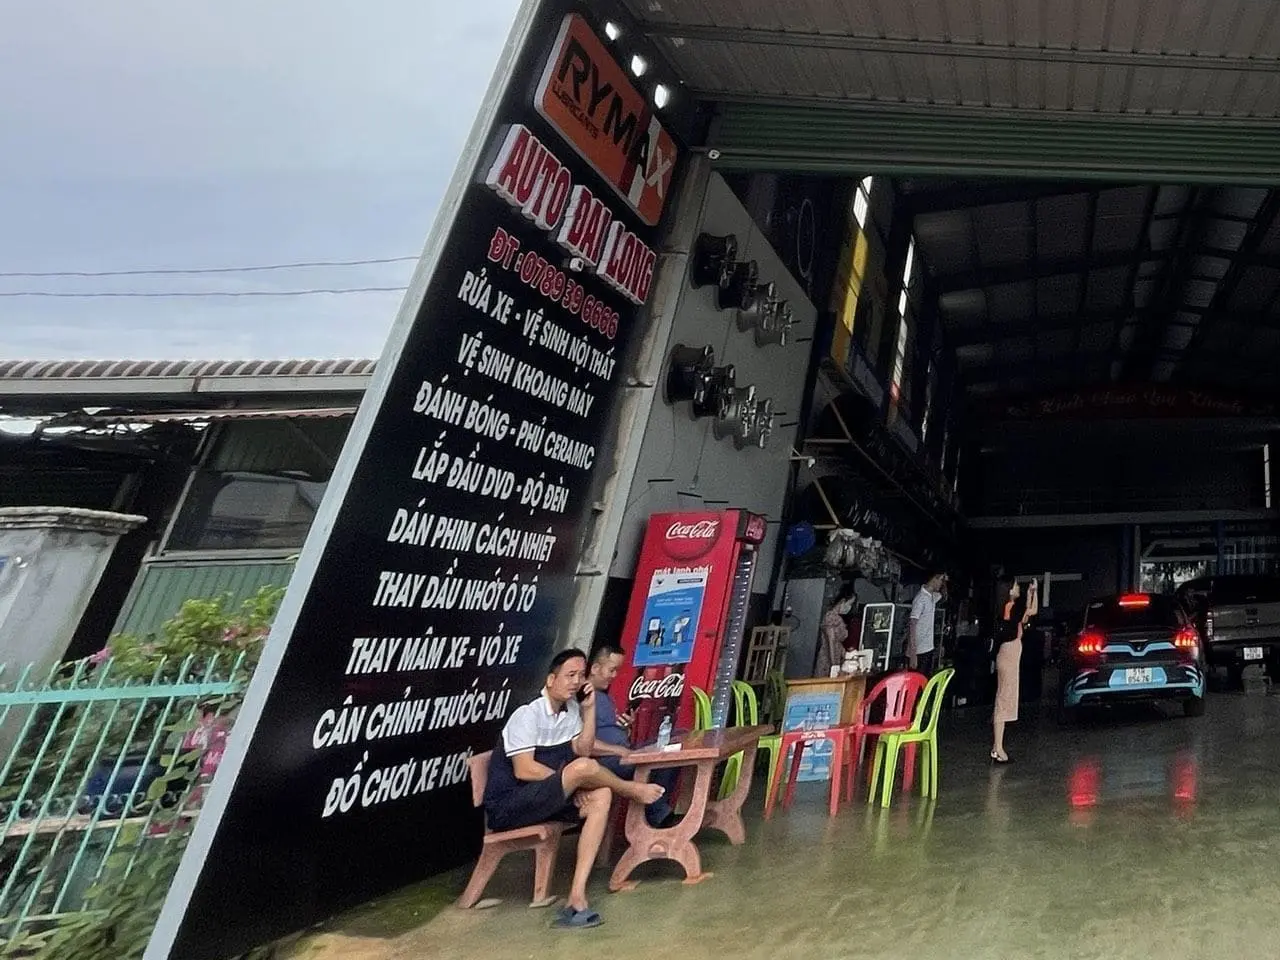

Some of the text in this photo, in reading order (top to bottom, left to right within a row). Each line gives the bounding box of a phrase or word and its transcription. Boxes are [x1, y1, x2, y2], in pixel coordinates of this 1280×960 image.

[559, 37, 673, 198] RYMAX
[488, 124, 572, 230] AUTO
[602, 221, 656, 305] LONG
[458, 267, 492, 314] RỬA
[490, 291, 515, 325] XE
[523, 308, 544, 346] VỆ
[540, 320, 571, 356] SINH
[567, 335, 591, 373] NỘI
[588, 346, 616, 381] THẤT
[562, 279, 584, 314] 39
[581, 295, 620, 339] 6666
[457, 331, 595, 418] VỆ SINH KHOANG MÁY
[412, 374, 468, 426] ĐÁNH
[463, 394, 510, 441] BÓNG
[514, 416, 548, 453] PHỦ
[544, 431, 596, 470] CERAMIC
[411, 430, 449, 483] LẮP
[446, 442, 485, 493] ĐẦU
[481, 468, 515, 500] DVD
[520, 471, 546, 516] ĐỘ
[542, 476, 570, 513] ĐÈN
[387, 497, 557, 570] DÁN PHIM CÁCH NHIỆT
[373, 557, 538, 613] THAY DẦU NHỚT Ô TÔ
[345, 637, 402, 675] THAY
[396, 626, 448, 672] MÂM
[442, 637, 472, 668] XE
[477, 622, 505, 667] VỎ
[499, 635, 523, 665] XE
[312, 677, 512, 750] CÂN CHỈNH THƯỚC LÁI
[321, 750, 369, 819] ĐỒ
[361, 757, 418, 808] CHƠI
[412, 756, 443, 795] XE
